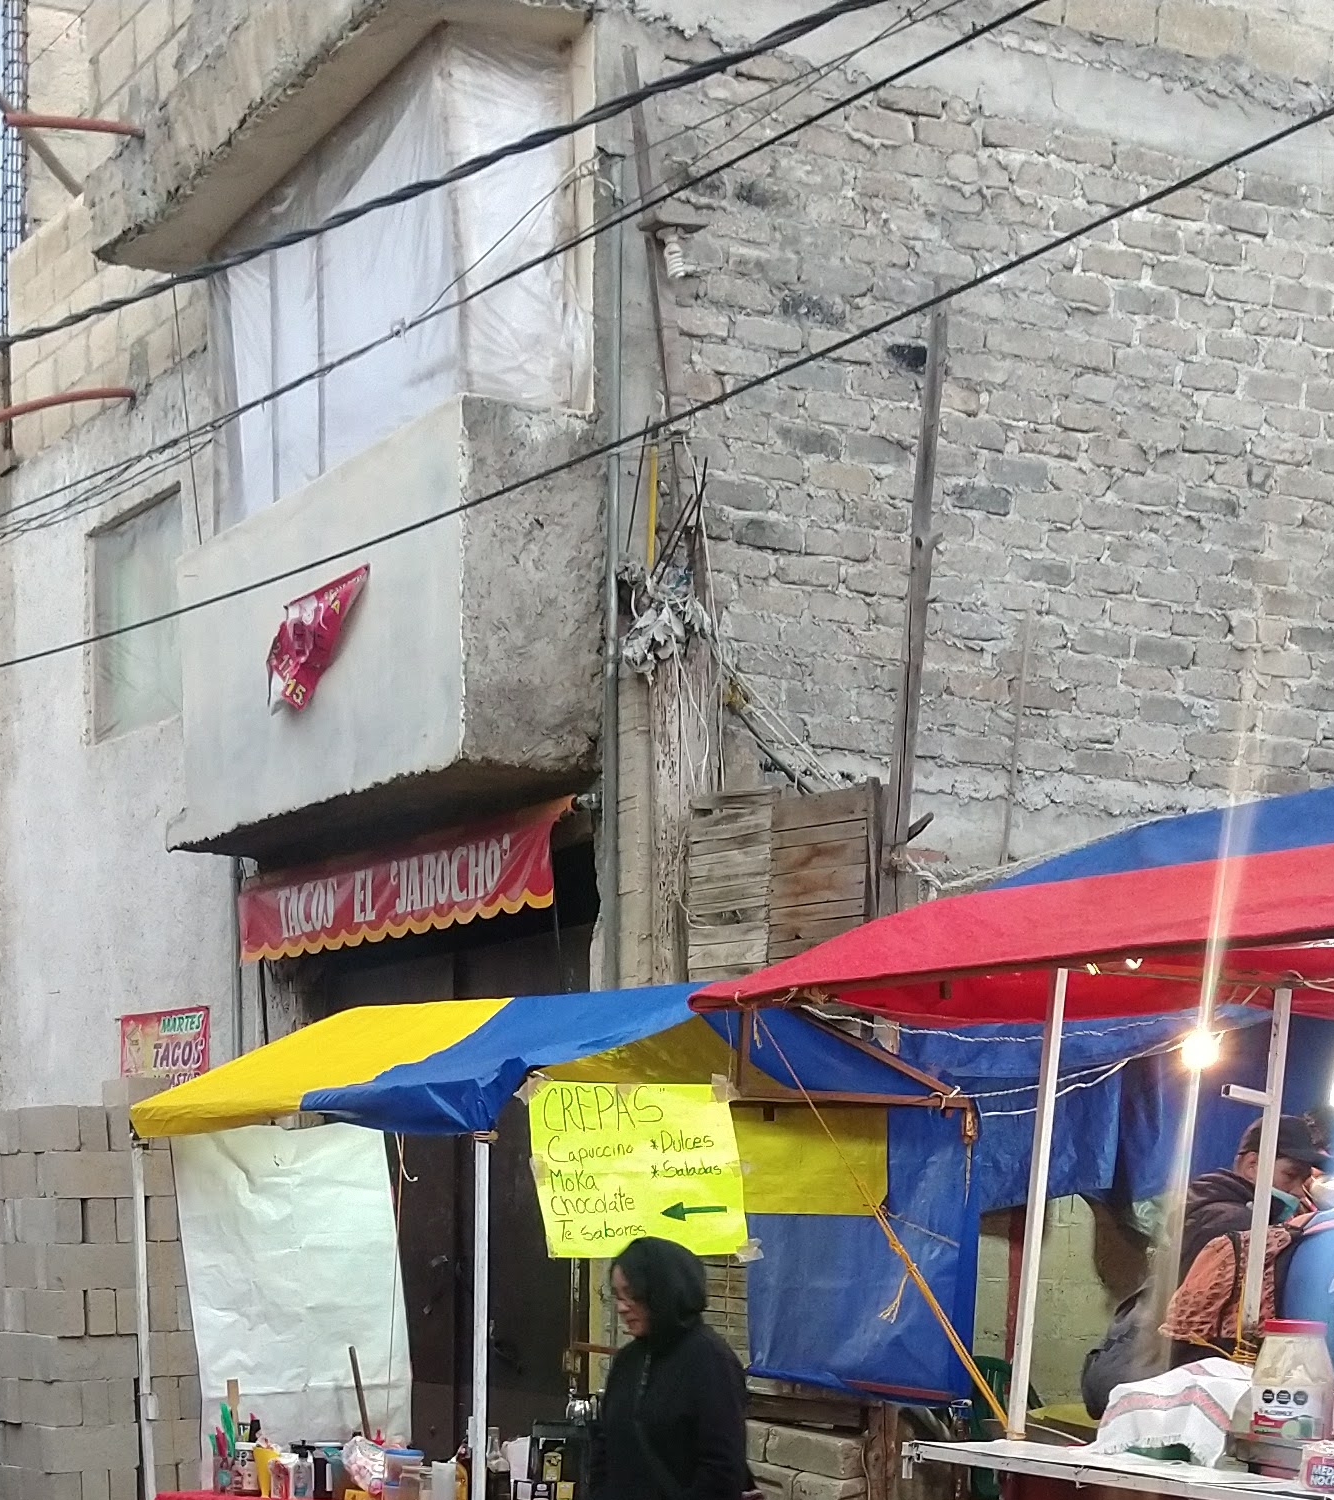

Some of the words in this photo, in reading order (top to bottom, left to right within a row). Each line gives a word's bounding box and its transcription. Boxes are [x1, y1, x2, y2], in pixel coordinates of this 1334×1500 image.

[277, 879, 338, 938] TACOS
[353, 868, 376, 923] EL
[160, 1012, 204, 1034] MARTES
[152, 1039, 205, 1069] TACOS
[547, 1135, 634, 1167] Capuccino
[554, 1220, 574, 1242] Te
